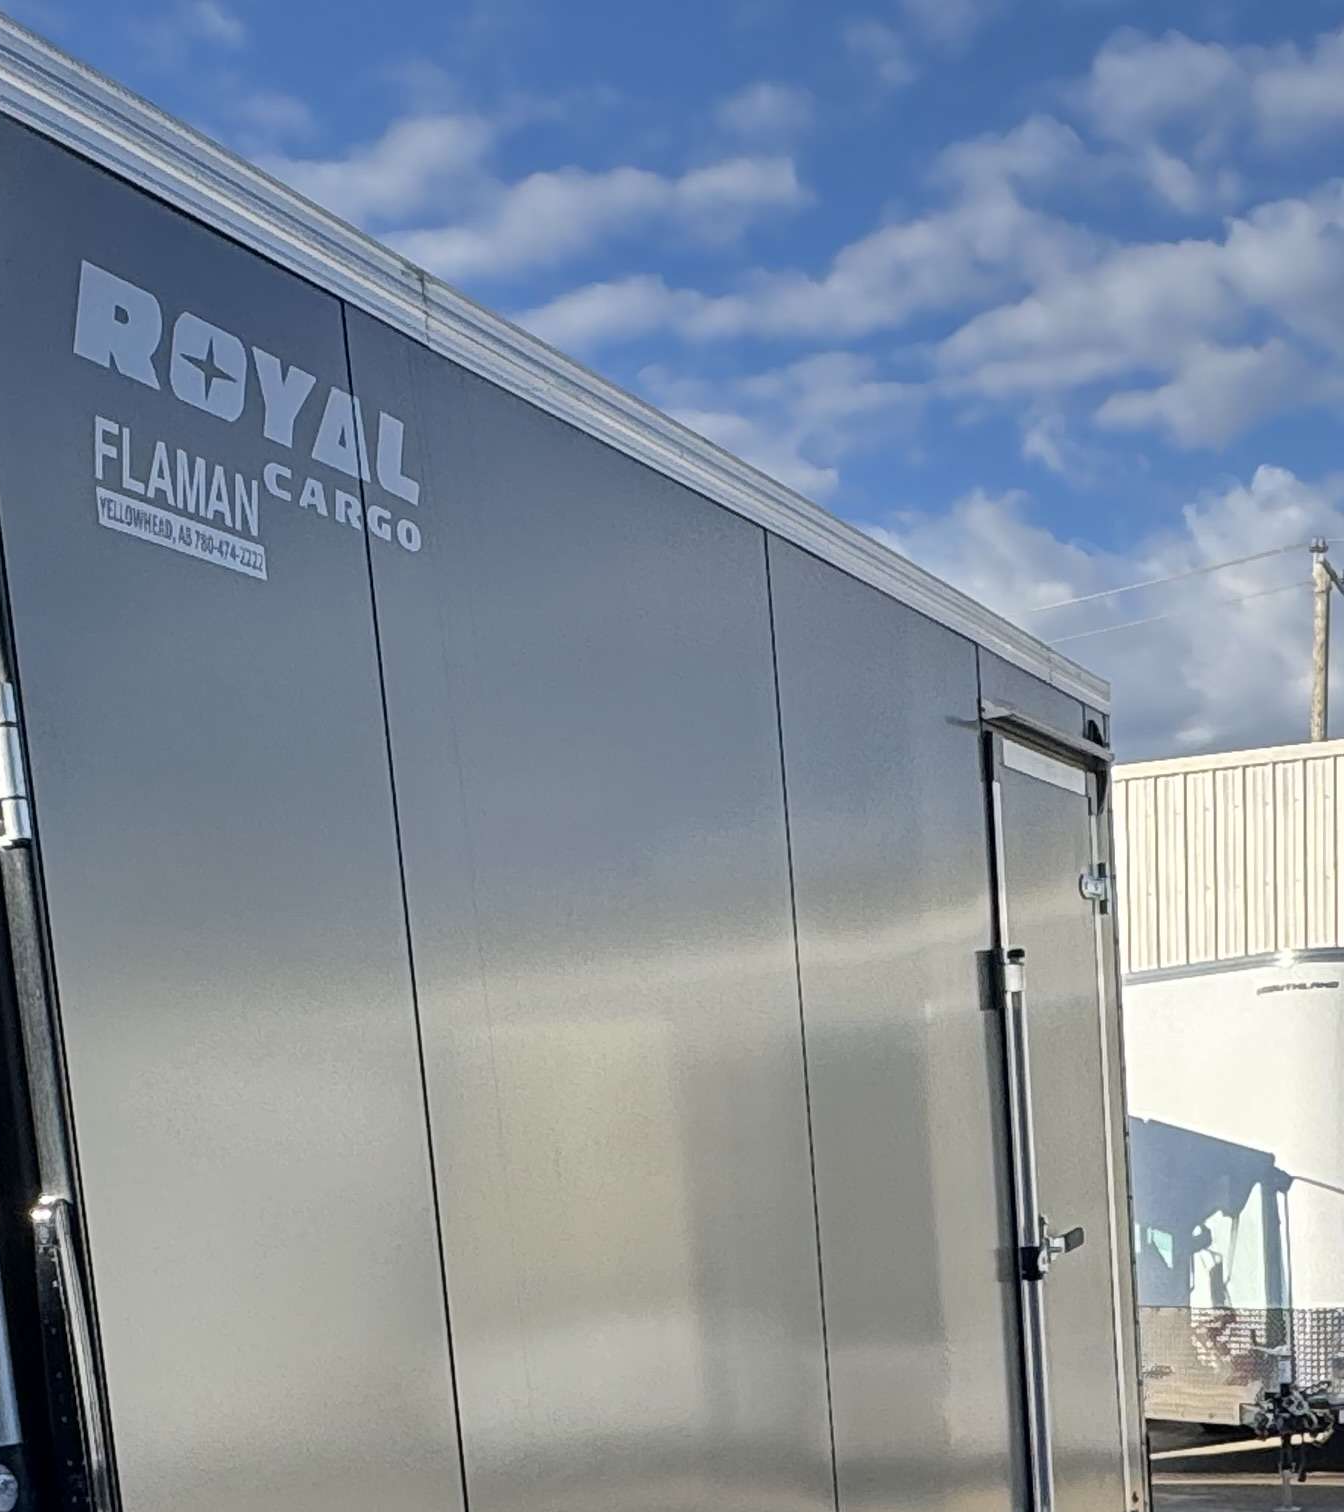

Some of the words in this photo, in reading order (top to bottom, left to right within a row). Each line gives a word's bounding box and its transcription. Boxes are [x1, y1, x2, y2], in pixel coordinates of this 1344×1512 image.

[73, 259, 420, 506] ROYAL
[94, 414, 259, 537] FLAMAN
[263, 461, 422, 553] CARGO
[99, 496, 177, 545] YELLOWHEAD,
[194, 529, 264, 573] 780-474-2222
